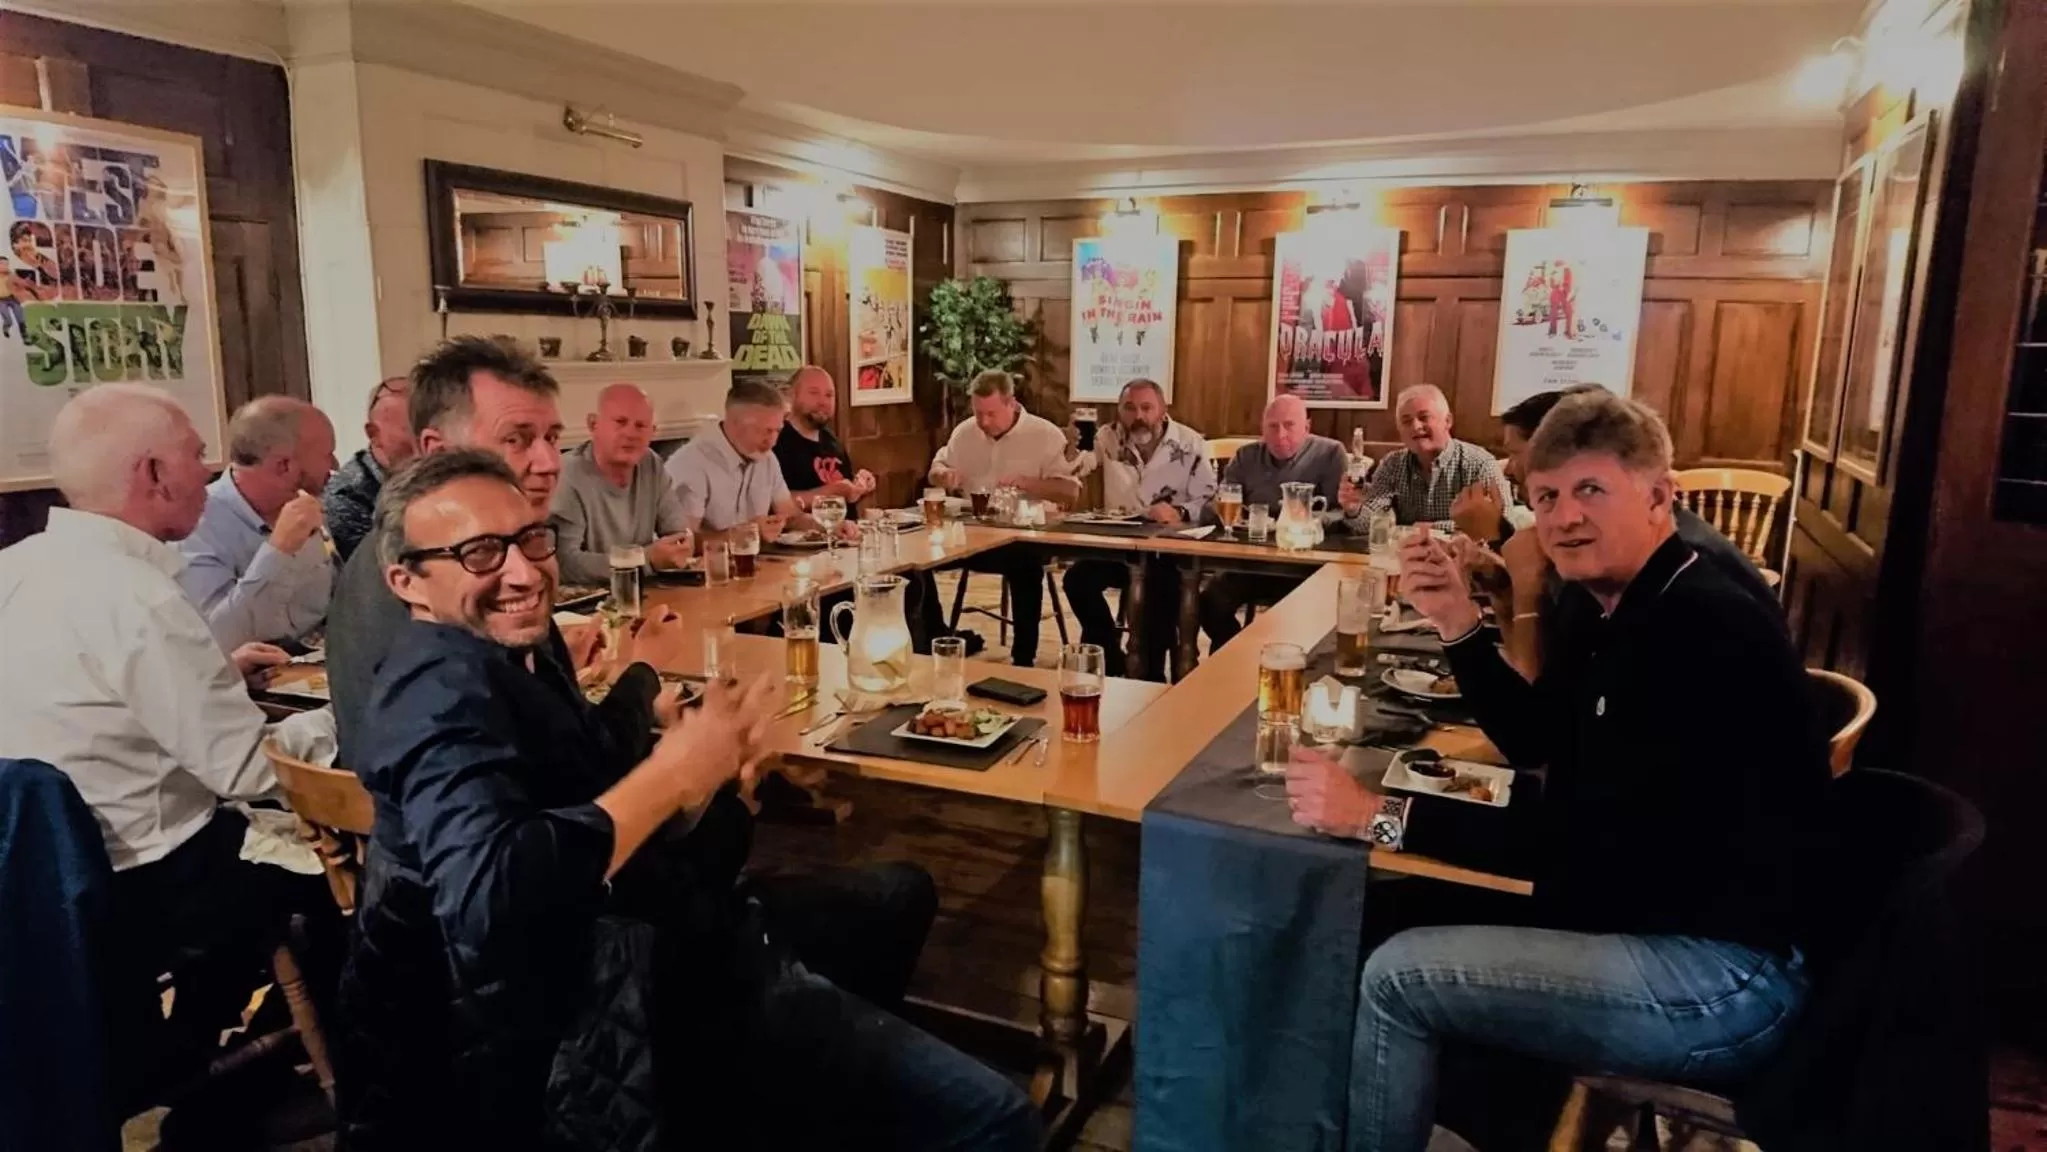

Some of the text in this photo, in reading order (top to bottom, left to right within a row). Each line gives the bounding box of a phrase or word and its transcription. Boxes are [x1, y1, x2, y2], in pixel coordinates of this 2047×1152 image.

[0, 134, 160, 225] WEST
[10, 220, 158, 302] SIDE
[747, 313, 791, 331] DAWN
[1081, 307, 1163, 324] IN THE RAIN
[25, 303, 188, 387] STORY
[752, 330, 768, 344] OF
[1279, 321, 1384, 365] DRACULA
[732, 344, 801, 370] DEAD
